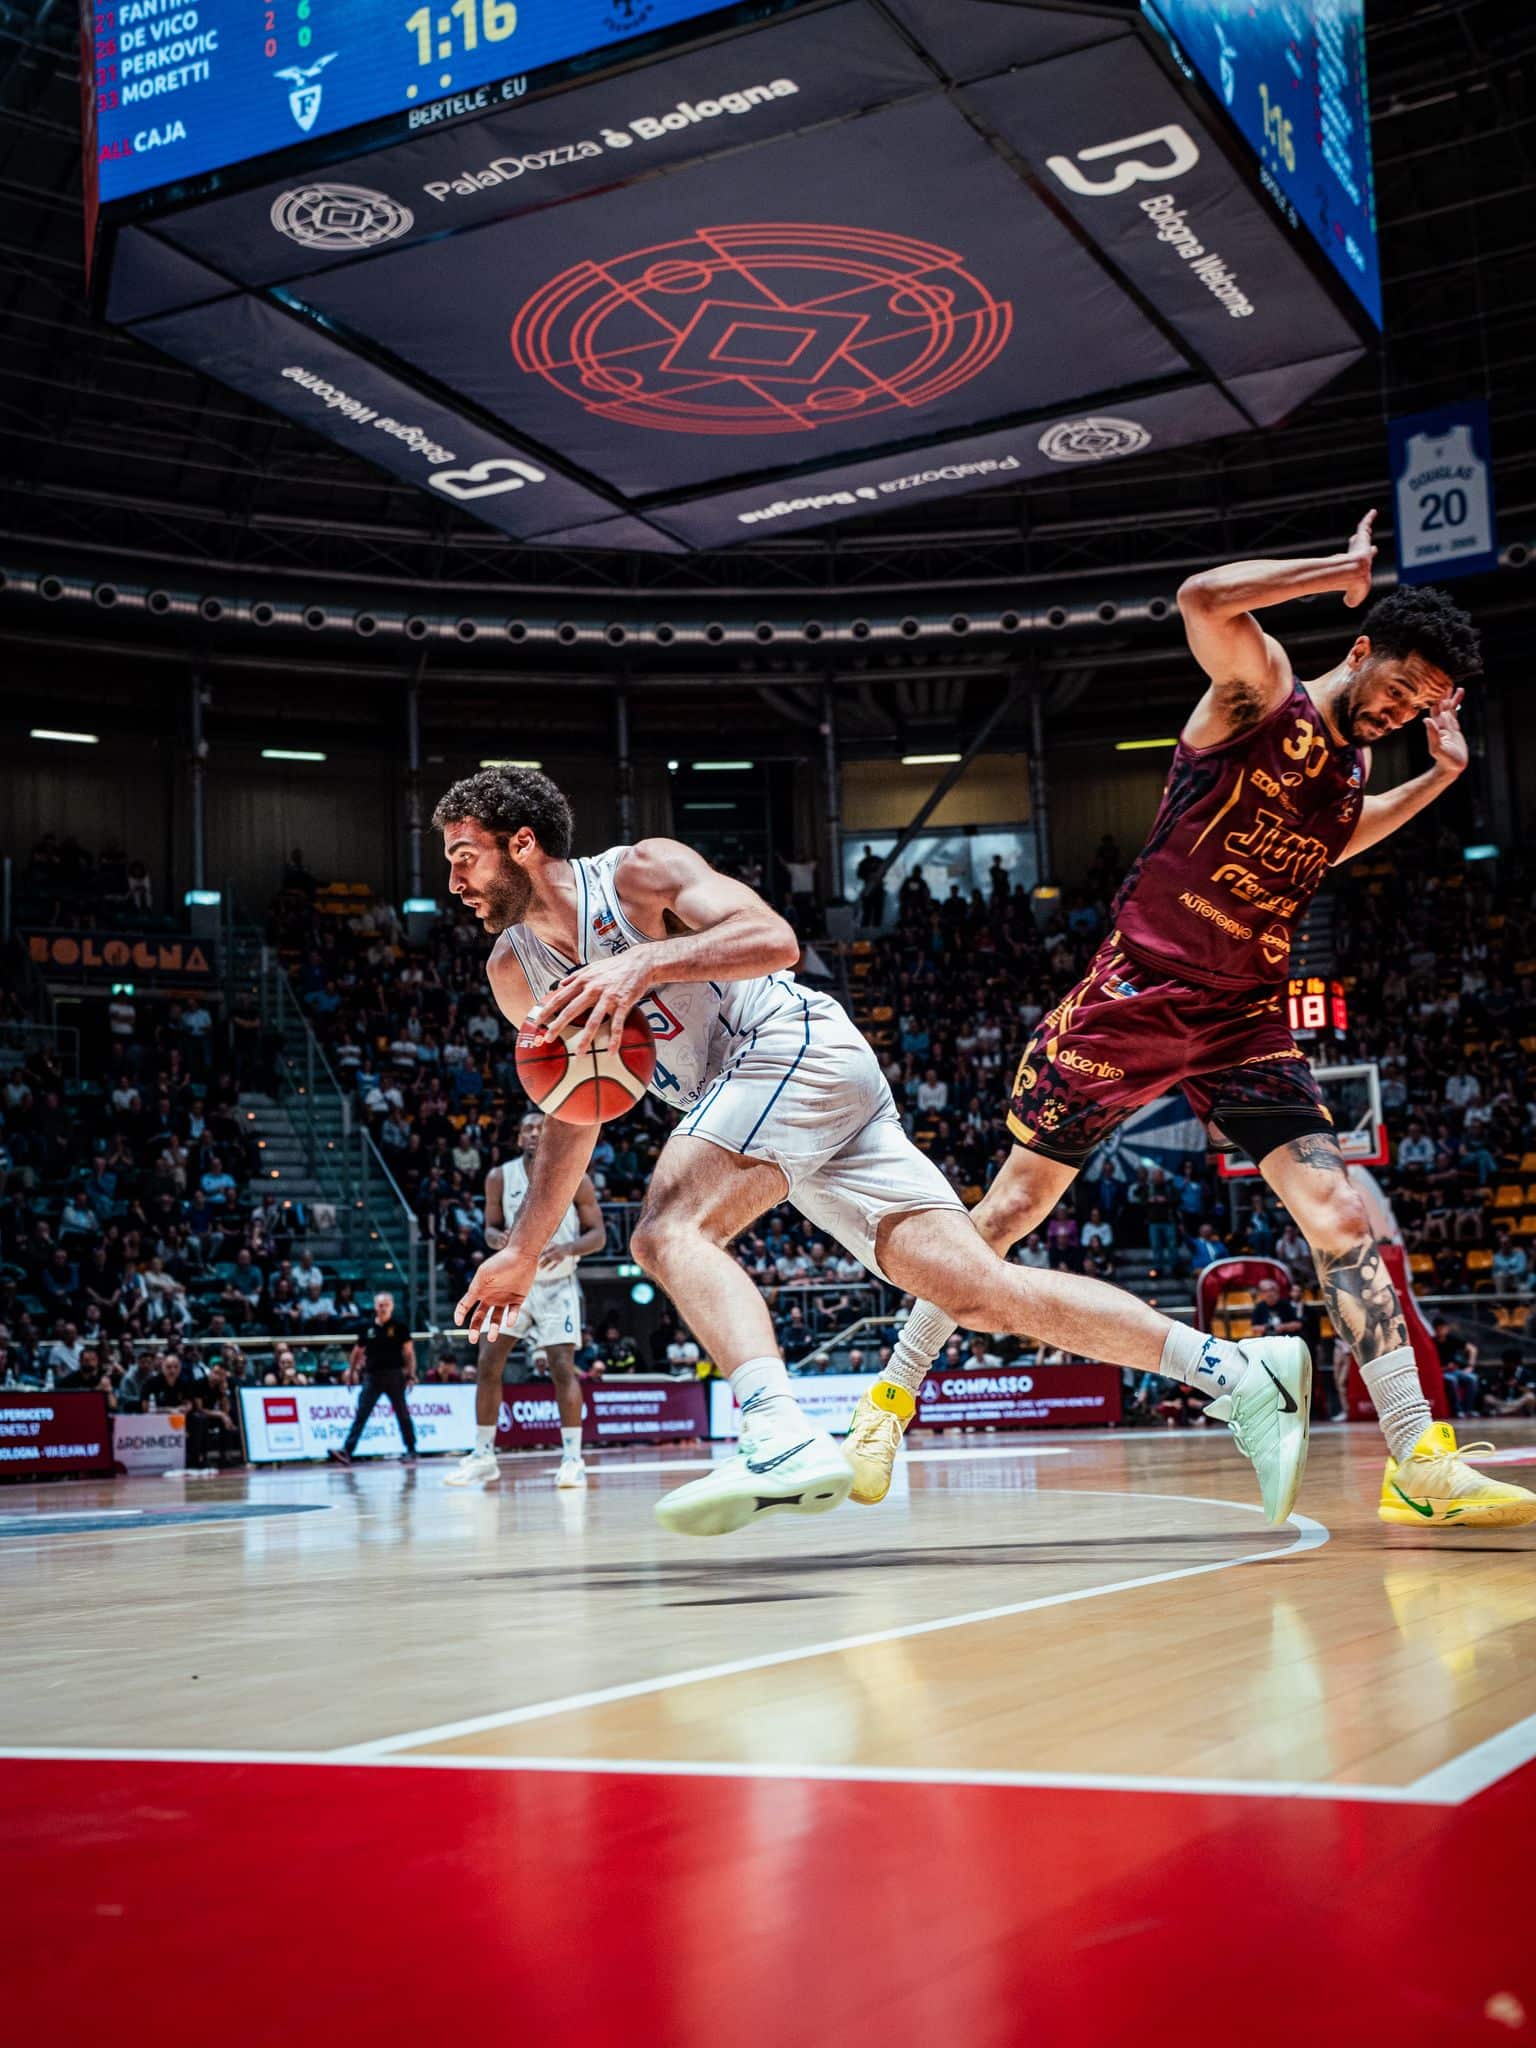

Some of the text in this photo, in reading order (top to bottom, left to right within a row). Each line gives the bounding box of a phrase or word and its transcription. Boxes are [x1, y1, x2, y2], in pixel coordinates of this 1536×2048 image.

[119, 26, 147, 53] DE
[149, 9, 198, 42] VICO
[120, 29, 219, 79] PERKOVIC
[264, 10, 275, 31] 2
[405, 0, 517, 66] 1:16
[121, 59, 210, 106] MORETTI
[133, 120, 187, 152] CAJA
[423, 139, 604, 202] PalaDozza
[628, 77, 799, 141] Bologna
[1139, 193, 1255, 319] Bologna Welcome
[280, 365, 457, 464] Welcome Bologna
[878, 455, 1021, 495] PalaDozza
[737, 489, 857, 525] Bologna
[1419, 488, 1468, 532] 20
[1282, 718, 1329, 779] 30
[1178, 889, 1254, 940] AUTOTORINO
[28, 935, 210, 972] BOLOGNA
[1288, 995, 1327, 1030] 18
[564, 1314, 574, 1334] 6
[942, 1374, 1034, 1397] COMPASSO
[1198, 1355, 1222, 1376] 14
